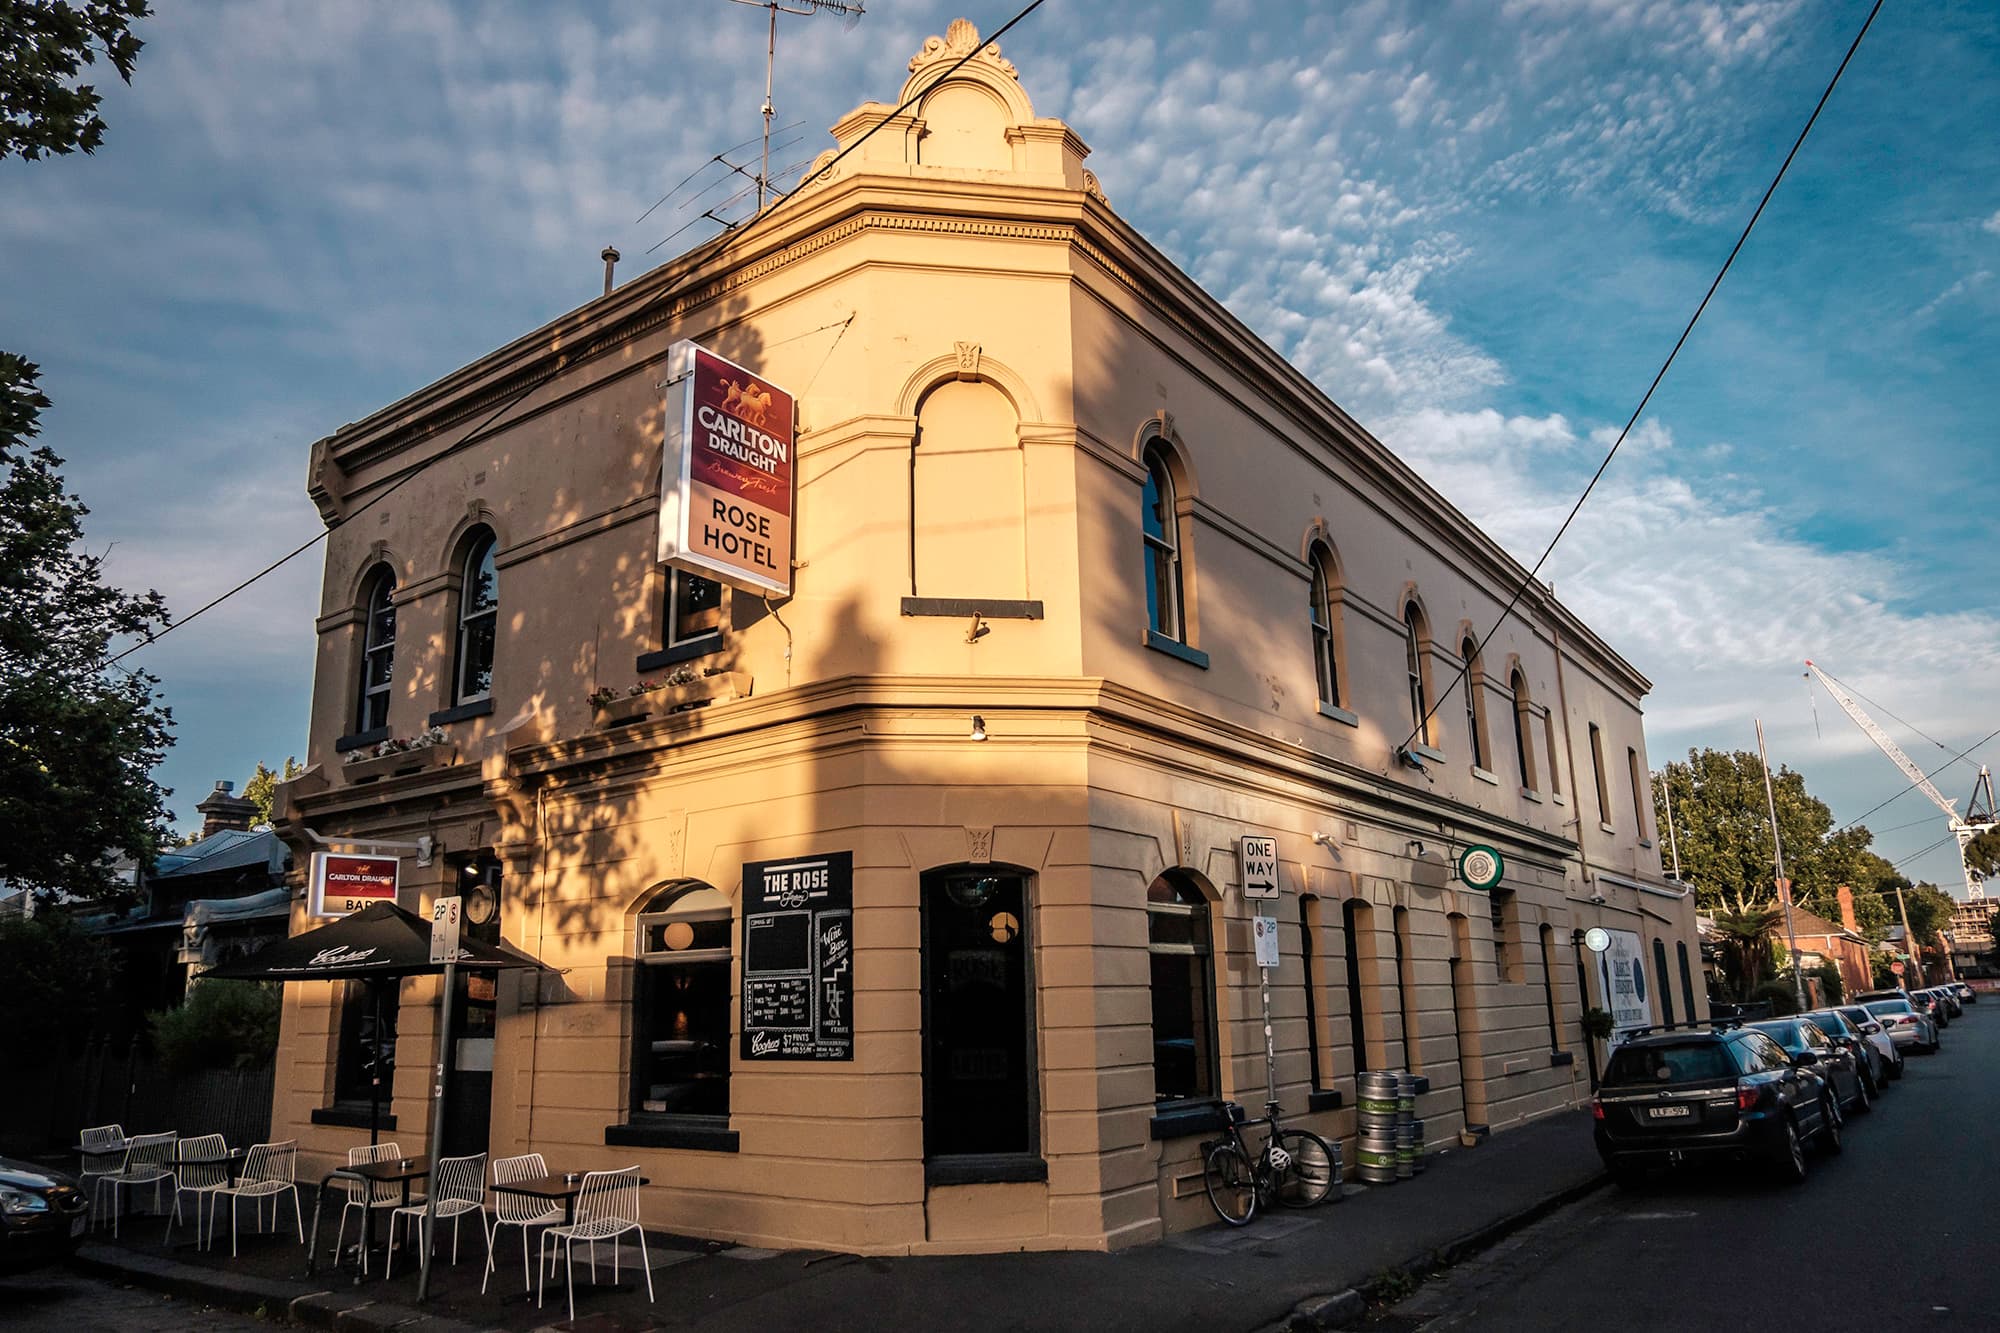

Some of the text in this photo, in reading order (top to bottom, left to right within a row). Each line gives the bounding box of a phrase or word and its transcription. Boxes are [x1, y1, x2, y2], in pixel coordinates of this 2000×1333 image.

[698, 406, 787, 463] CARLTON
[709, 433, 777, 473] DRAUGHT
[713, 498, 770, 539] ROSE
[704, 524, 777, 570] HOTEL
[1247, 842, 1272, 857] ONE
[329, 873, 394, 883] CARLTON DRAUGHT
[1246, 861, 1274, 876] WAY
[763, 869, 828, 894] THE ROSE
[434, 904, 446, 920] 2P
[1266, 921, 1276, 933] 2P
